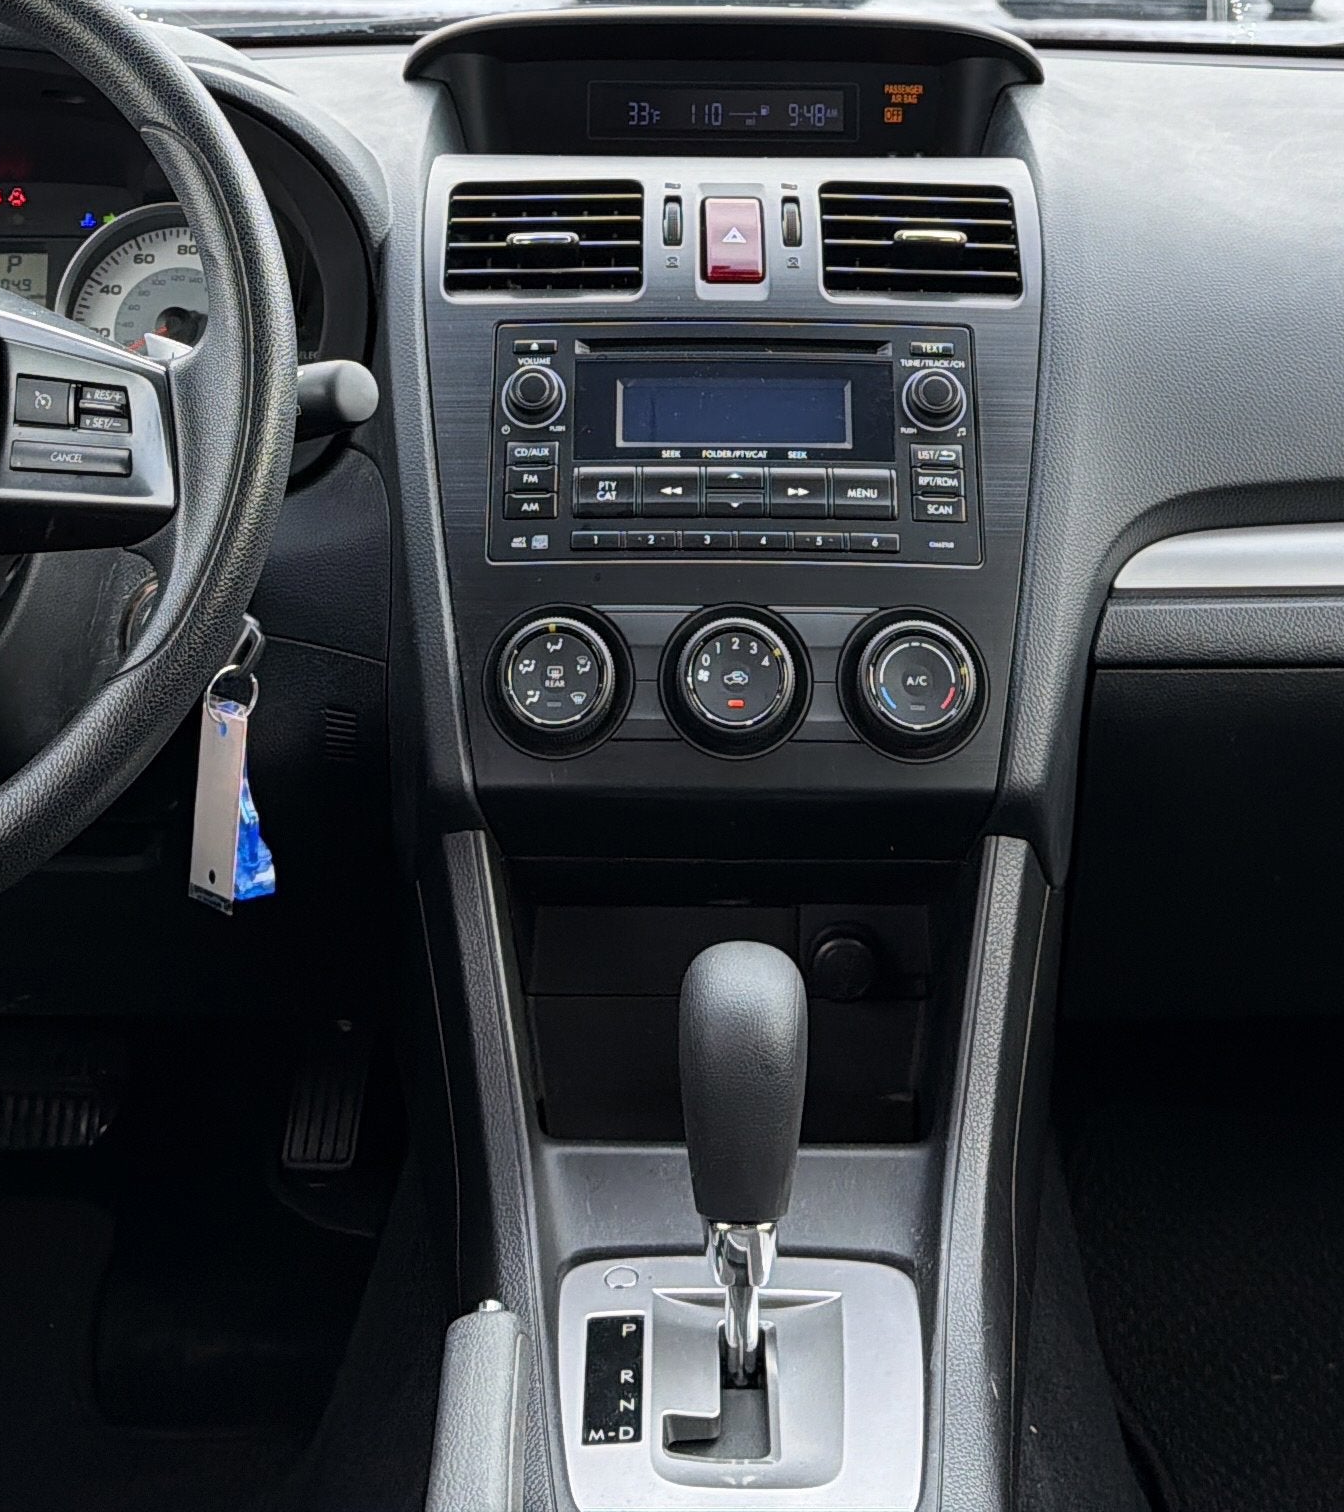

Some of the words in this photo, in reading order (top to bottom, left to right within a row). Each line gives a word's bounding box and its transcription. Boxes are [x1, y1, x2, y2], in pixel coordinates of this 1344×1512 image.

[884, 84, 924, 94] PASSENGER
[690, 102, 723, 127] 110
[787, 103, 826, 127] 9:48
[825, 108, 839, 118] AM
[886, 108, 901, 122] OFF
[177, 244, 199, 256] 80
[7, 254, 23, 274] P
[133, 253, 157, 265] 60
[99, 284, 123, 296] 40
[921, 344, 944, 354] TEXT
[518, 357, 551, 366] VOLUME
[900, 358, 965, 368] TUNE/TRACK/CH
[50, 450, 84, 464] CANCEL
[514, 447, 550, 458] CD/AUX
[661, 449, 681, 458] SEEK
[701, 449, 768, 459] FOLDER/PTY/CAT
[787, 450, 808, 460] SEEK
[523, 472, 539, 484] FM
[598, 480, 617, 491] PTY
[596, 491, 618, 502] CAT
[847, 487, 878, 500] MENU
[521, 501, 540, 513] AM
[926, 503, 953, 515] SCAN
[593, 535, 599, 545] 1
[647, 535, 656, 545] 2
[704, 535, 711, 545] 3
[760, 535, 768, 546] 4
[816, 536, 823, 546] 5
[871, 538, 879, 548] 6
[714, 643, 721, 655] 1
[731, 637, 740, 650] 2
[749, 643, 759, 655] 3
[701, 654, 711, 667] 0
[761, 656, 771, 668] 4
[544, 678, 566, 688] REAR
[906, 674, 928, 688] A/C
[622, 1322, 637, 1338] P
[620, 1369, 635, 1384] R
[619, 1397, 635, 1412] N
